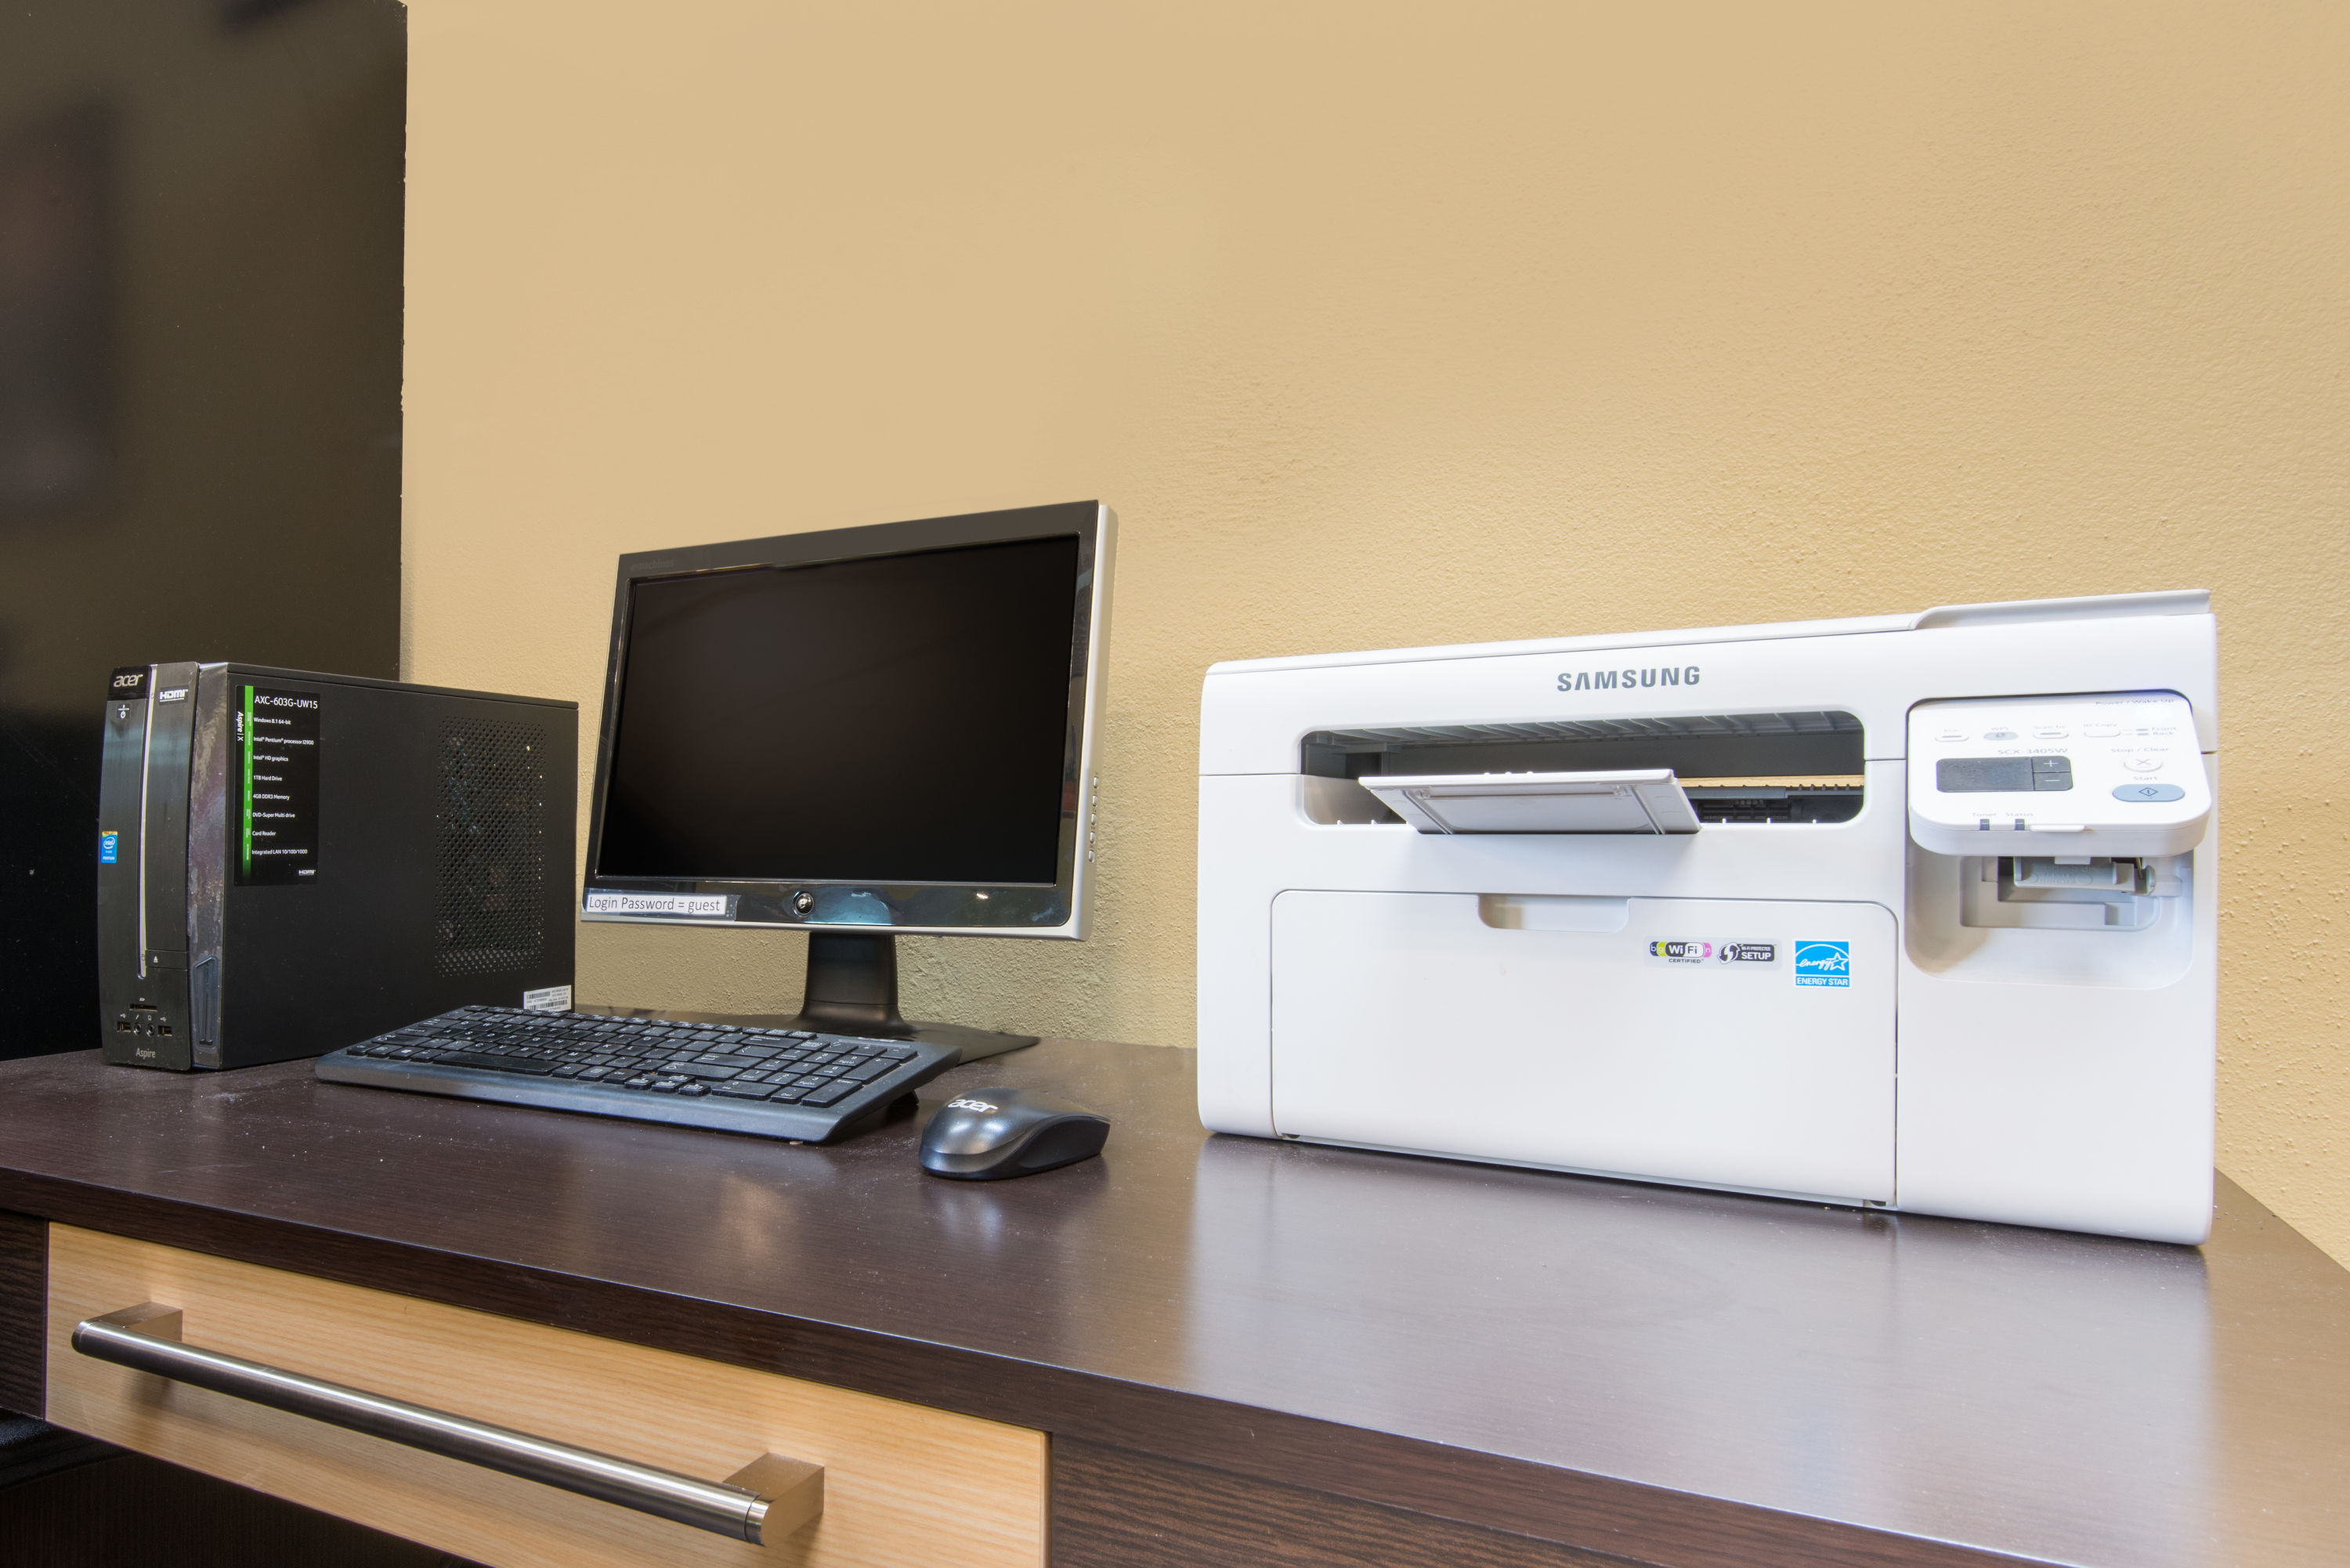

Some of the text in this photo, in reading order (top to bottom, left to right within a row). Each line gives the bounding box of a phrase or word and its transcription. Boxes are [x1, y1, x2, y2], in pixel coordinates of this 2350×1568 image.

[113, 674, 143, 688] acer
[1556, 666, 1701, 692] SAMSUNG
[159, 688, 188, 699] HDMI
[254, 695, 318, 709] AXC-603G-UW15
[589, 896, 618, 912] Login
[621, 897, 674, 911] Password
[688, 900, 721, 914] guest
[1741, 952, 1771, 960] SETUP
[1799, 958, 1833, 971] energy
[1828, 977, 1849, 986] STAR
[136, 1047, 156, 1060] Aspire
[948, 1099, 999, 1113] acer
